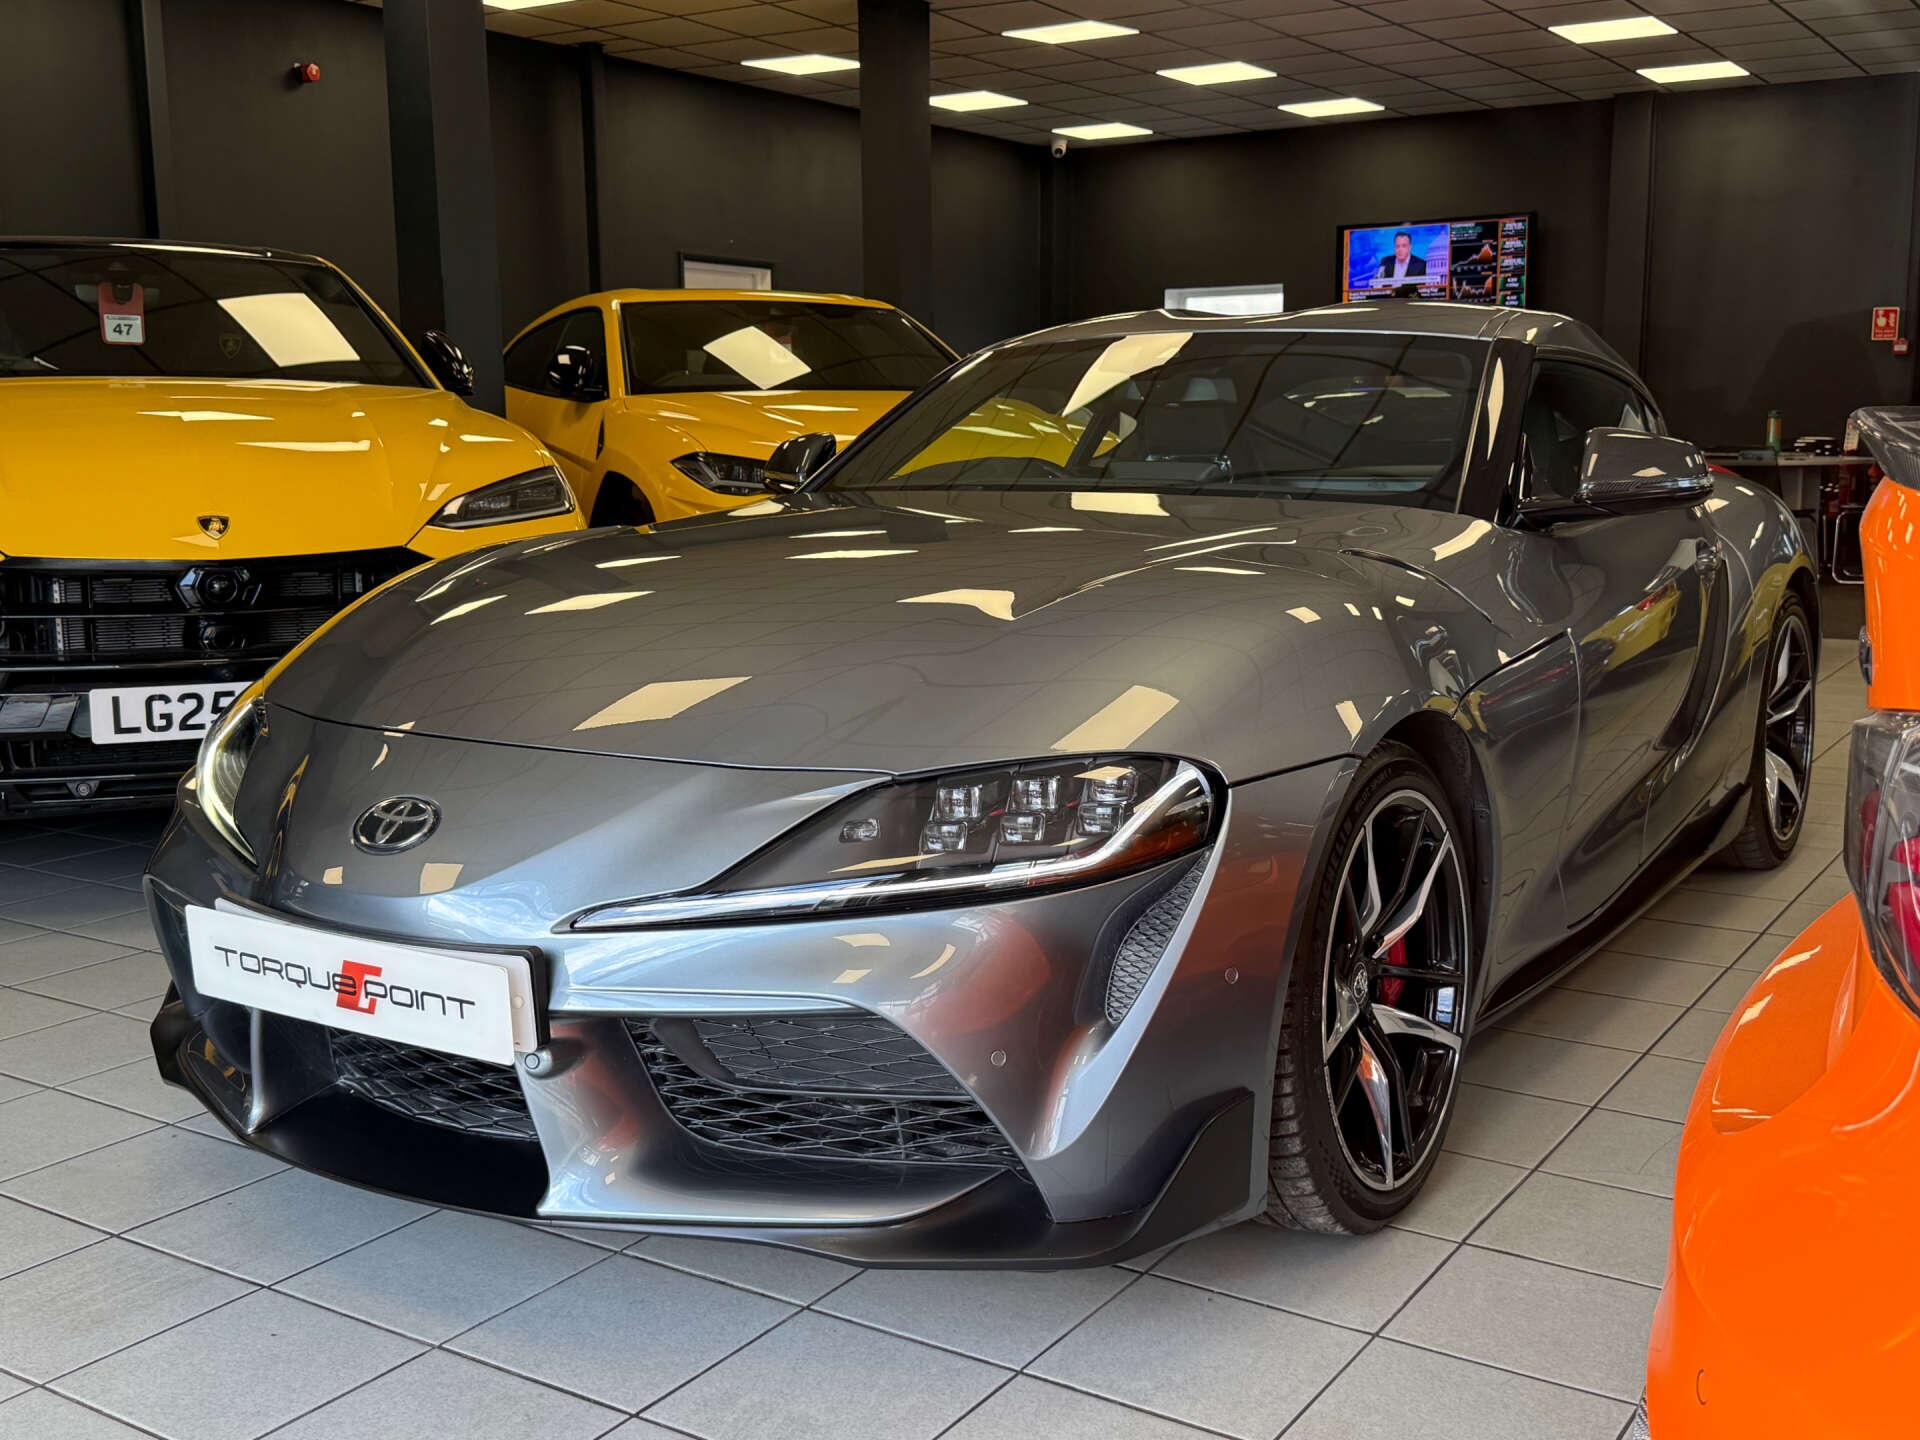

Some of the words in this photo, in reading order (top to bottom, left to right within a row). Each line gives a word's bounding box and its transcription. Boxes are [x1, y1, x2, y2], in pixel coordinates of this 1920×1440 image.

[112, 323, 134, 336] 47
[214, 945, 357, 996] TORQUE
[364, 979, 476, 1020] POINT
